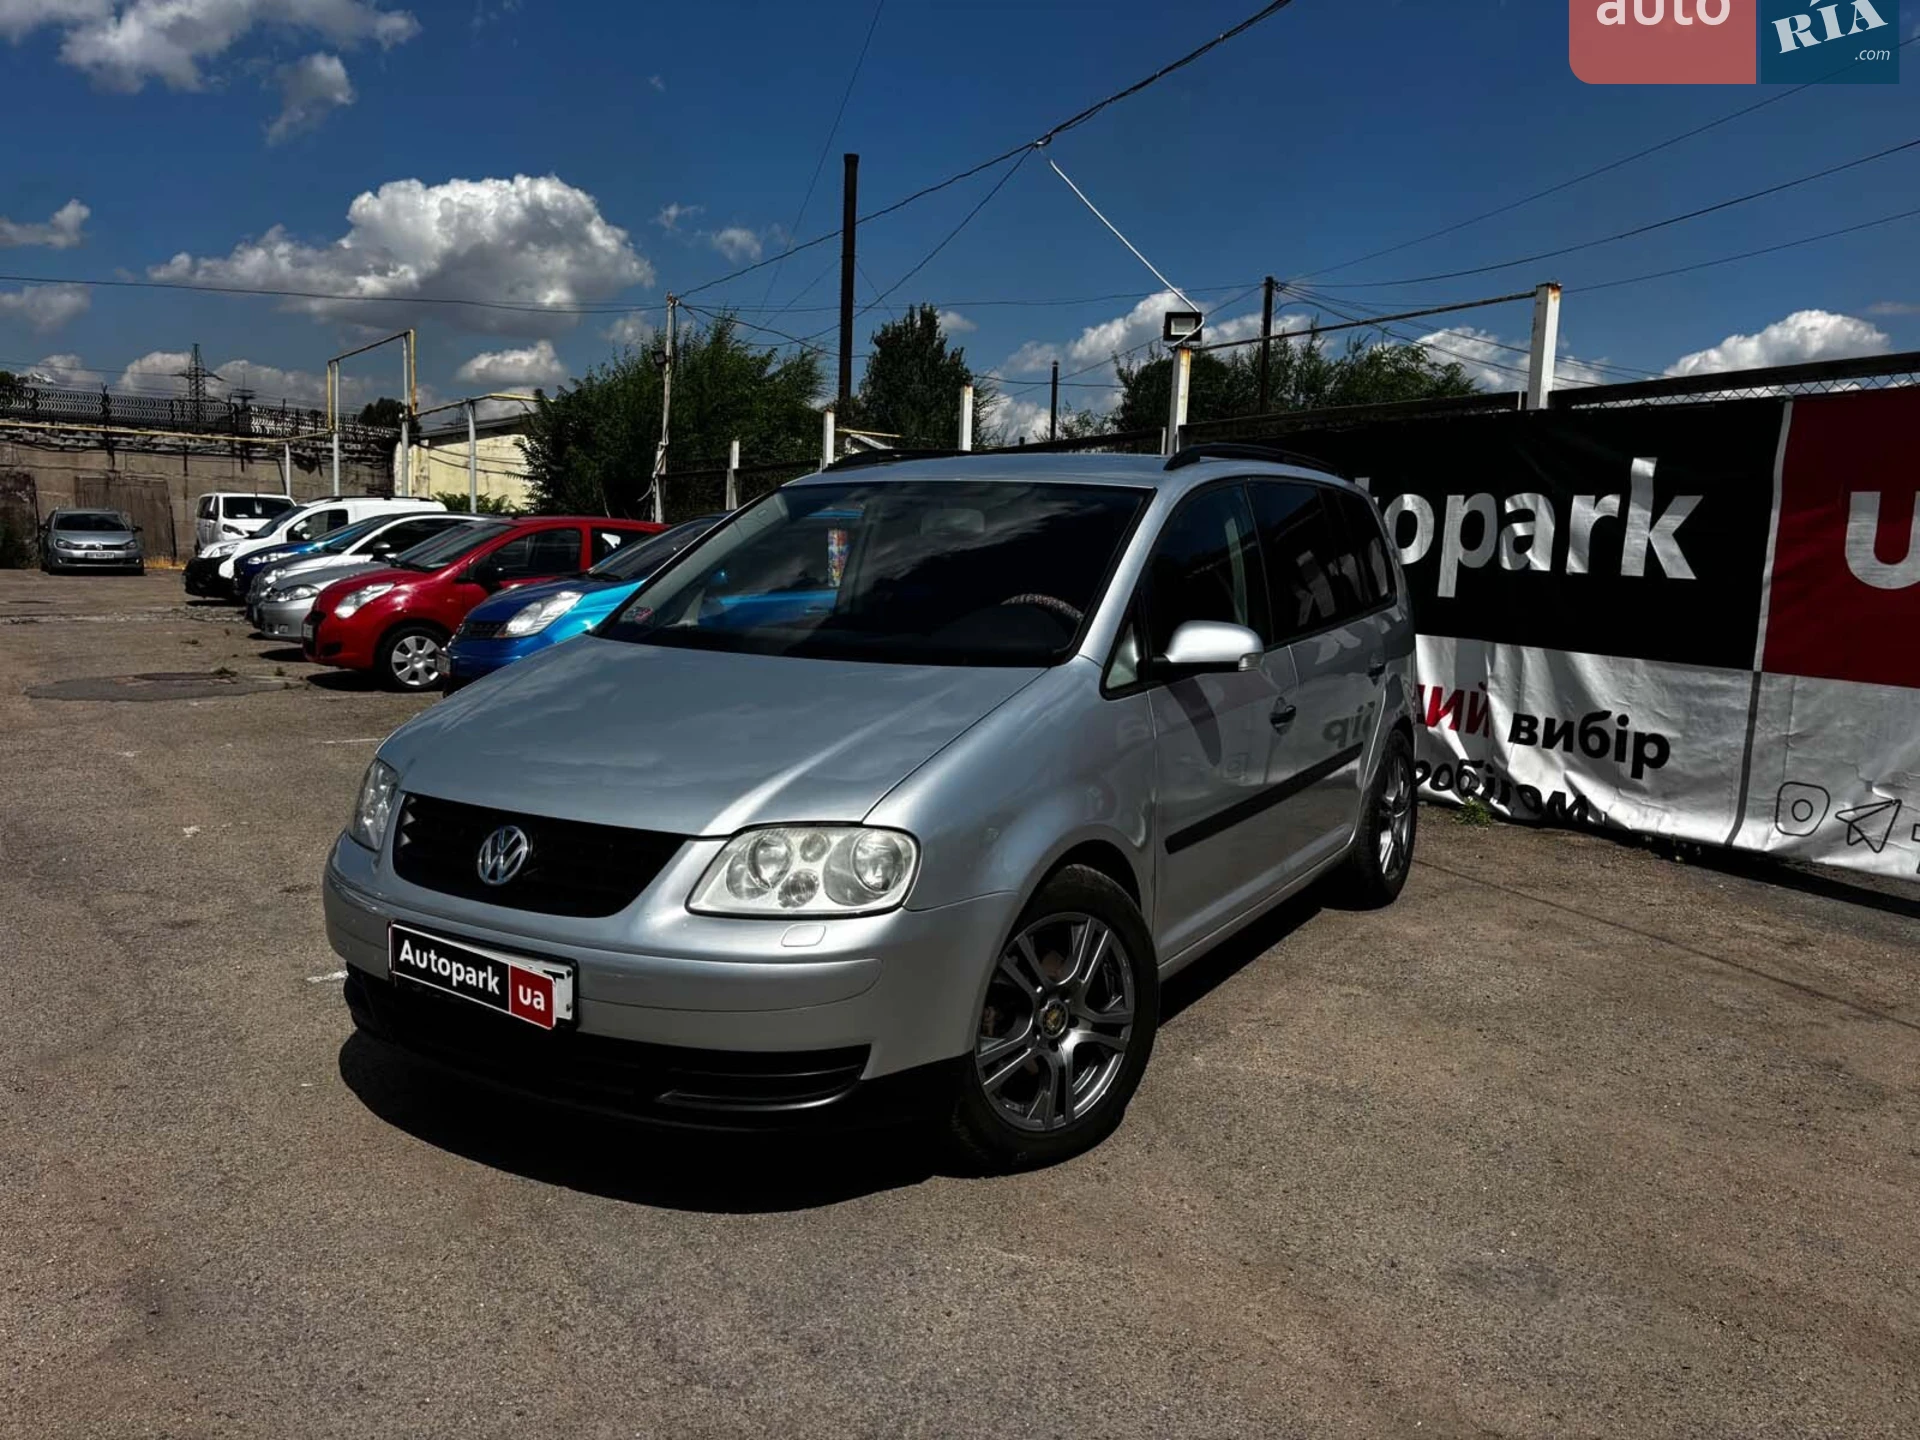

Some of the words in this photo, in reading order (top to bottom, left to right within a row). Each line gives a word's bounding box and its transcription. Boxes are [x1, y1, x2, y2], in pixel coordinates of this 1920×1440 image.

[1354, 456, 1704, 599] opark
[1416, 682, 1491, 738] ий
[1507, 710, 1671, 779] вибір
[399, 939, 500, 995] Autopark
[518, 984, 546, 1012] ua
